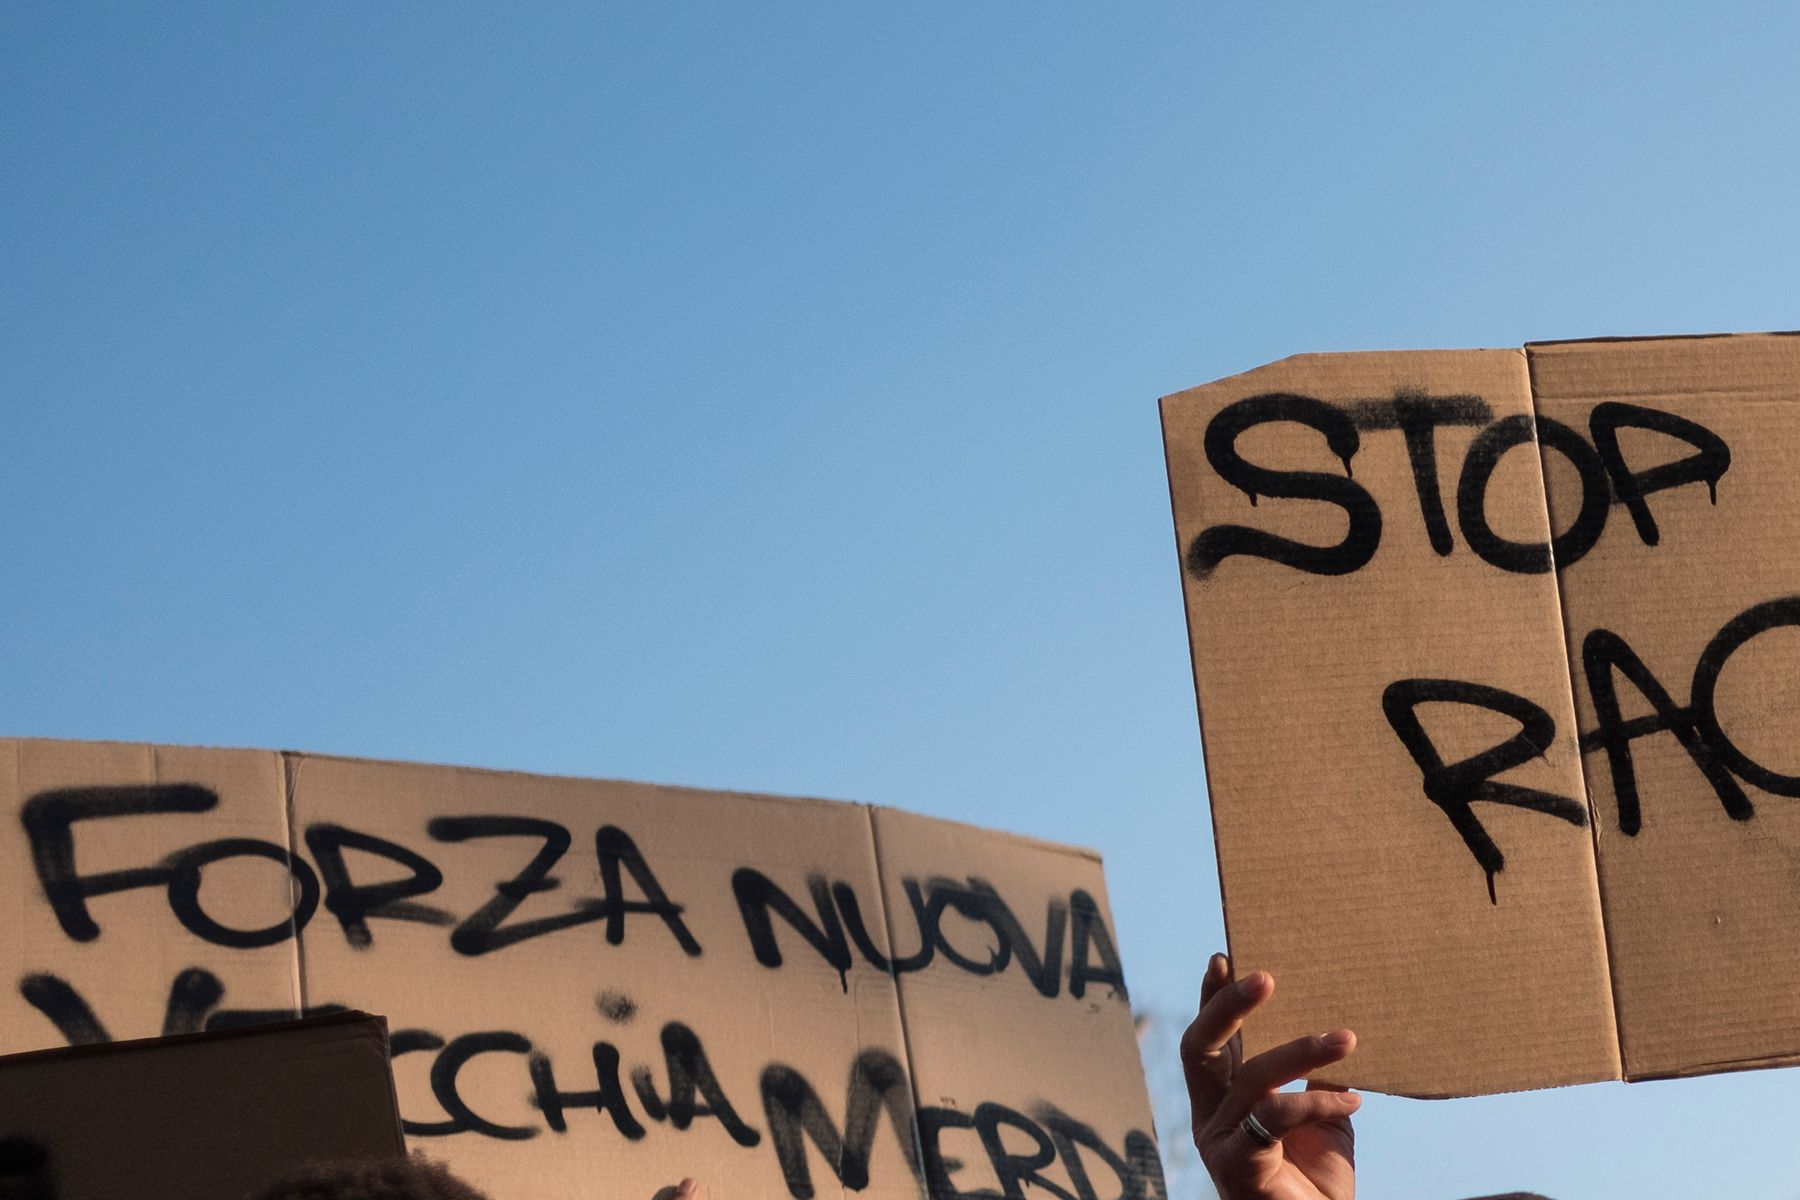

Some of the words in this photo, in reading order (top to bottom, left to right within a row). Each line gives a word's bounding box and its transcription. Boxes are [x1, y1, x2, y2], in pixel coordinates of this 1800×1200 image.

[1187, 386, 1732, 578] STOP
[18, 781, 704, 957] FORZA
[730, 866, 1131, 1004] NUOVA
